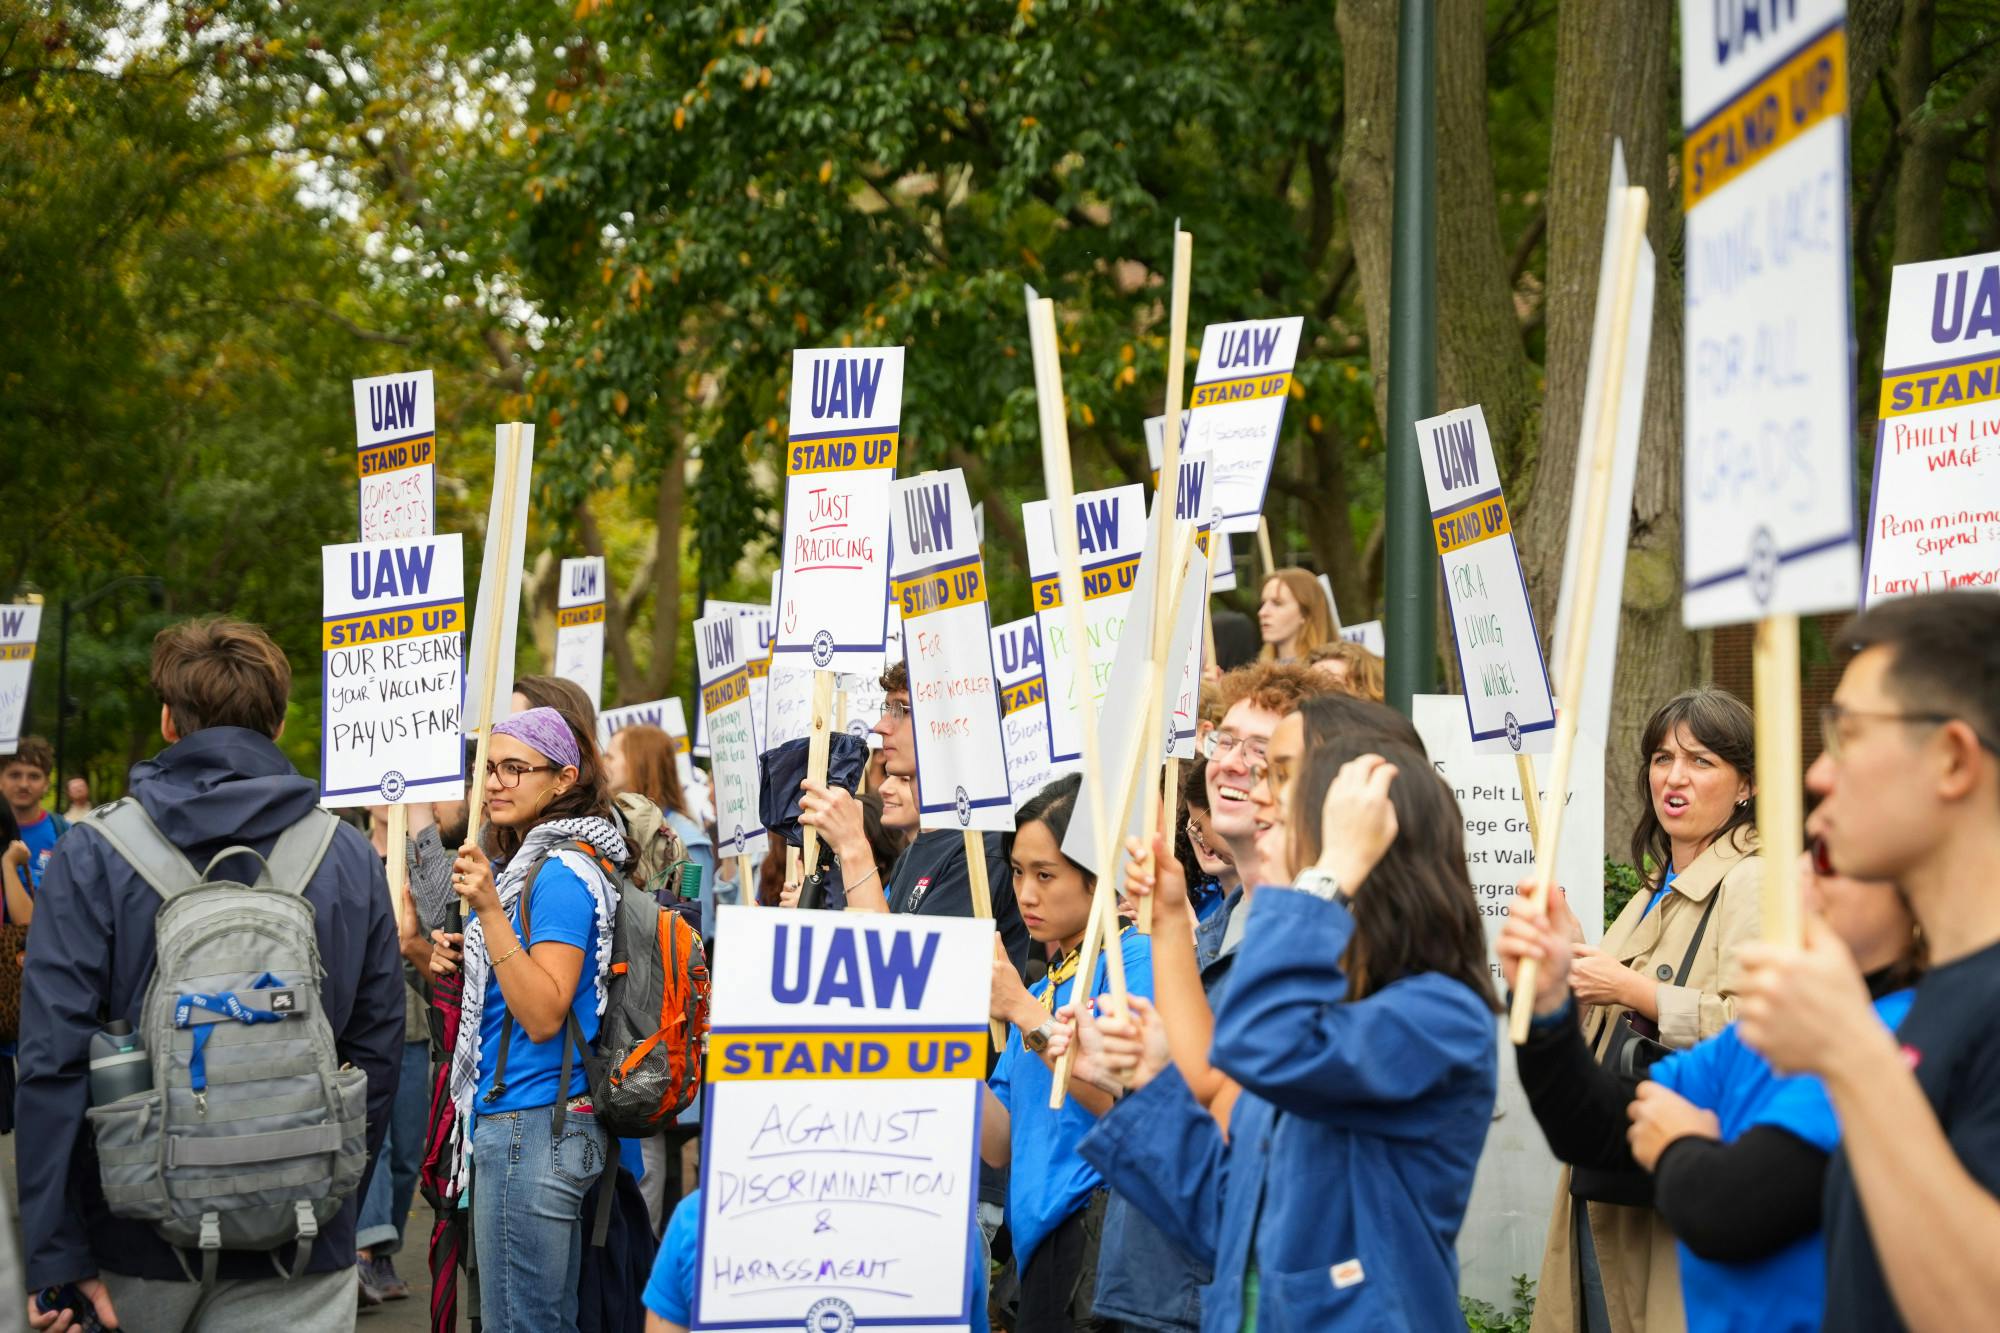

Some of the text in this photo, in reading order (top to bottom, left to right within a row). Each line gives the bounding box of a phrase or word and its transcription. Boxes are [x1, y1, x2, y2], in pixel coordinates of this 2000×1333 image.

[1692, 55, 1835, 194] STAND UP
[1931, 265, 2000, 344] UA
[1217, 326, 1282, 369] UAW
[370, 381, 417, 432] UAW
[810, 358, 884, 419] UAW
[1196, 377, 1285, 404] STAND UP
[1432, 418, 1480, 491] UAW
[1895, 421, 1958, 455] PHILLY
[1971, 418, 2000, 441] LIV
[362, 442, 430, 474] STAND UP
[792, 439, 892, 471] STAND UP
[1927, 445, 1981, 471] WAGE
[364, 473, 422, 509] COMPUTER
[809, 488, 853, 522] JUST
[1176, 461, 1205, 520] AW
[903, 482, 953, 555] UAW
[1438, 503, 1503, 548] STAND UP
[1881, 513, 1924, 539] Penn
[795, 535, 873, 565] PRACTICING
[351, 545, 435, 600] UAW
[572, 565, 598, 597] UAW
[1040, 572, 1111, 606] STND
[1452, 563, 1488, 603] FOR A
[903, 578, 949, 614] STAND
[954, 570, 979, 600] UP
[330, 608, 457, 645] STAND UP
[561, 606, 602, 625] STAND UP
[1464, 614, 1503, 649] LIVING
[704, 616, 734, 670] UAW
[918, 632, 943, 661] FOR
[999, 626, 1042, 674] UA
[331, 648, 376, 678] OUR
[1480, 661, 1519, 698] WAGE!
[380, 670, 455, 703] VACCINE!
[705, 676, 747, 710] STAND UP
[917, 681, 943, 702] GRAD
[1005, 682, 1043, 711] TAN
[333, 704, 460, 757] PAY US FAIR!
[1473, 786, 1504, 800] Pelt
[1495, 849, 1536, 864] Walk
[771, 923, 941, 1010] UAW
[722, 1041, 972, 1074] STAND UP
[750, 1103, 938, 1151] AGAINST
[716, 1169, 955, 1214] DISCRIMINATION
[713, 1257, 899, 1291] HARASSMENT
